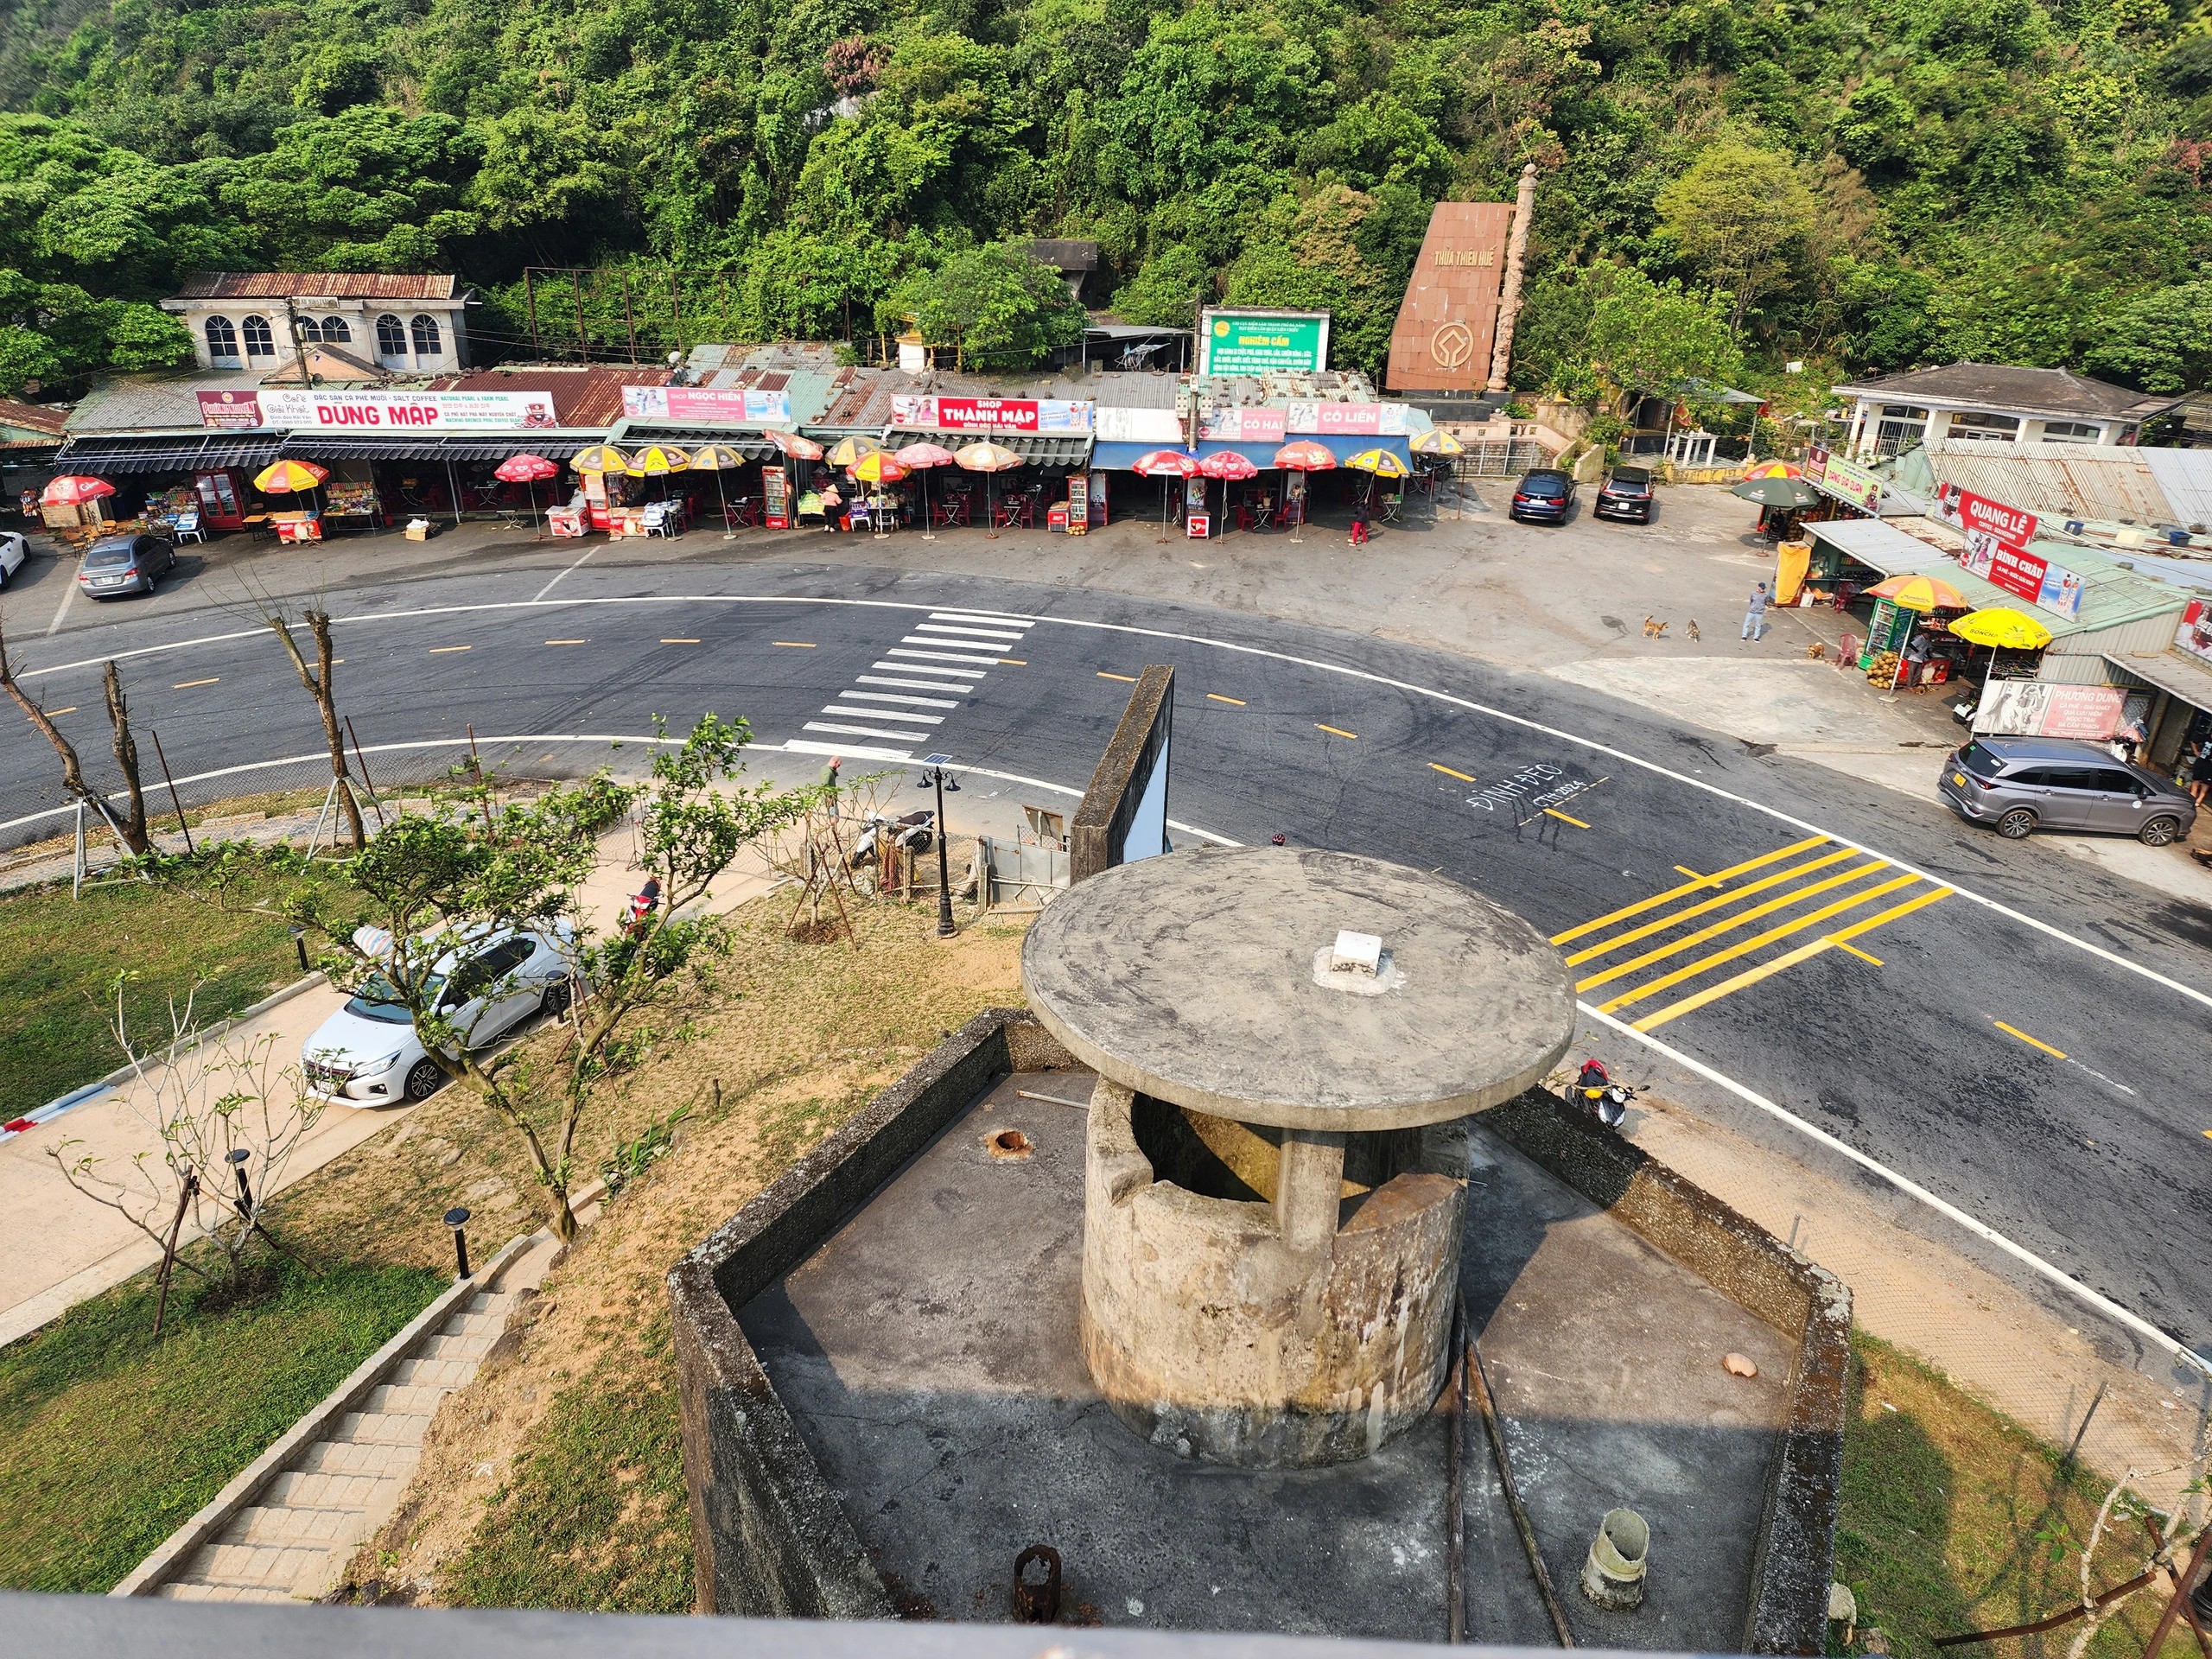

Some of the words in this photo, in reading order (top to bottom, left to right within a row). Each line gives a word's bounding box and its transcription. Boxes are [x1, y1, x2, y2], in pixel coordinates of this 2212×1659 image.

[1456, 247, 1478, 266] THIÊN
[1478, 245, 1497, 267] HUẾ
[388, 403, 438, 427] MẬP
[944, 407, 998, 423] THÀNH
[1001, 408, 1035, 425] MẬP
[1244, 418, 1260, 429] CÔ
[1262, 420, 1283, 429] HAI
[1322, 410, 1343, 423] CÔ
[1970, 500, 2011, 528] QUANG
[2009, 514, 2028, 535] LÊ
[1978, 520, 1993, 531] COFFEE
[1995, 549, 2019, 569] BÌNH
[2018, 560, 2044, 580] CHÂU
[1555, 780, 1587, 796] 2024
